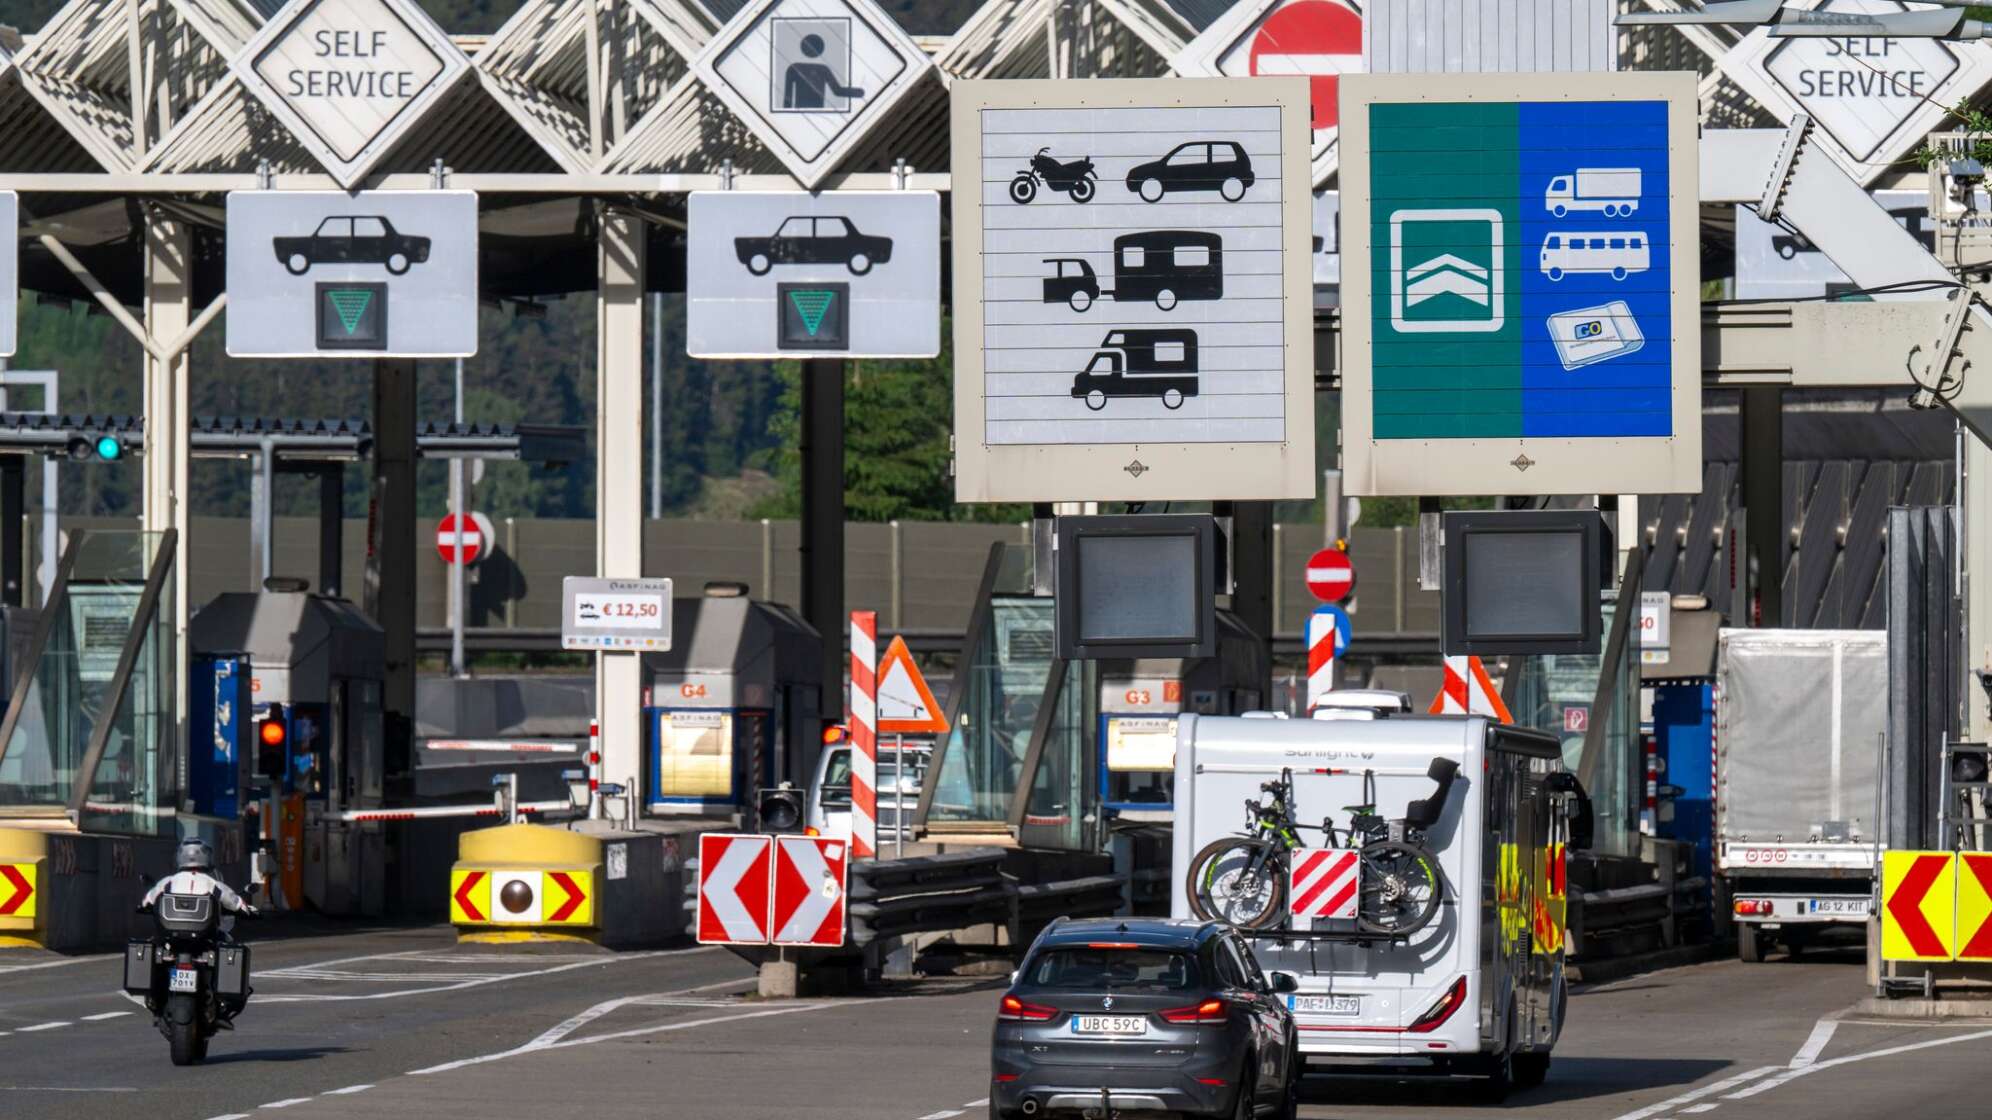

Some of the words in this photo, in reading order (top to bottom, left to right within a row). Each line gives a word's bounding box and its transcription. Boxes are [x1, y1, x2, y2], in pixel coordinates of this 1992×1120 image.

[315, 30, 386, 57] SELF
[1826, 38, 1898, 57] SELF
[288, 69, 413, 98] SERVICE
[1799, 69, 1926, 98] SERVICE
[1576, 321, 1602, 339] GO
[602, 602, 612, 616] €
[616, 603, 657, 618] 12,50
[681, 684, 705, 698] G4
[1125, 690, 1151, 704] G3
[1834, 902, 1843, 911] 12
[1847, 902, 1863, 911] KIT
[1083, 1020, 1109, 1031] UBC
[1114, 1020, 1140, 1031] 59C
